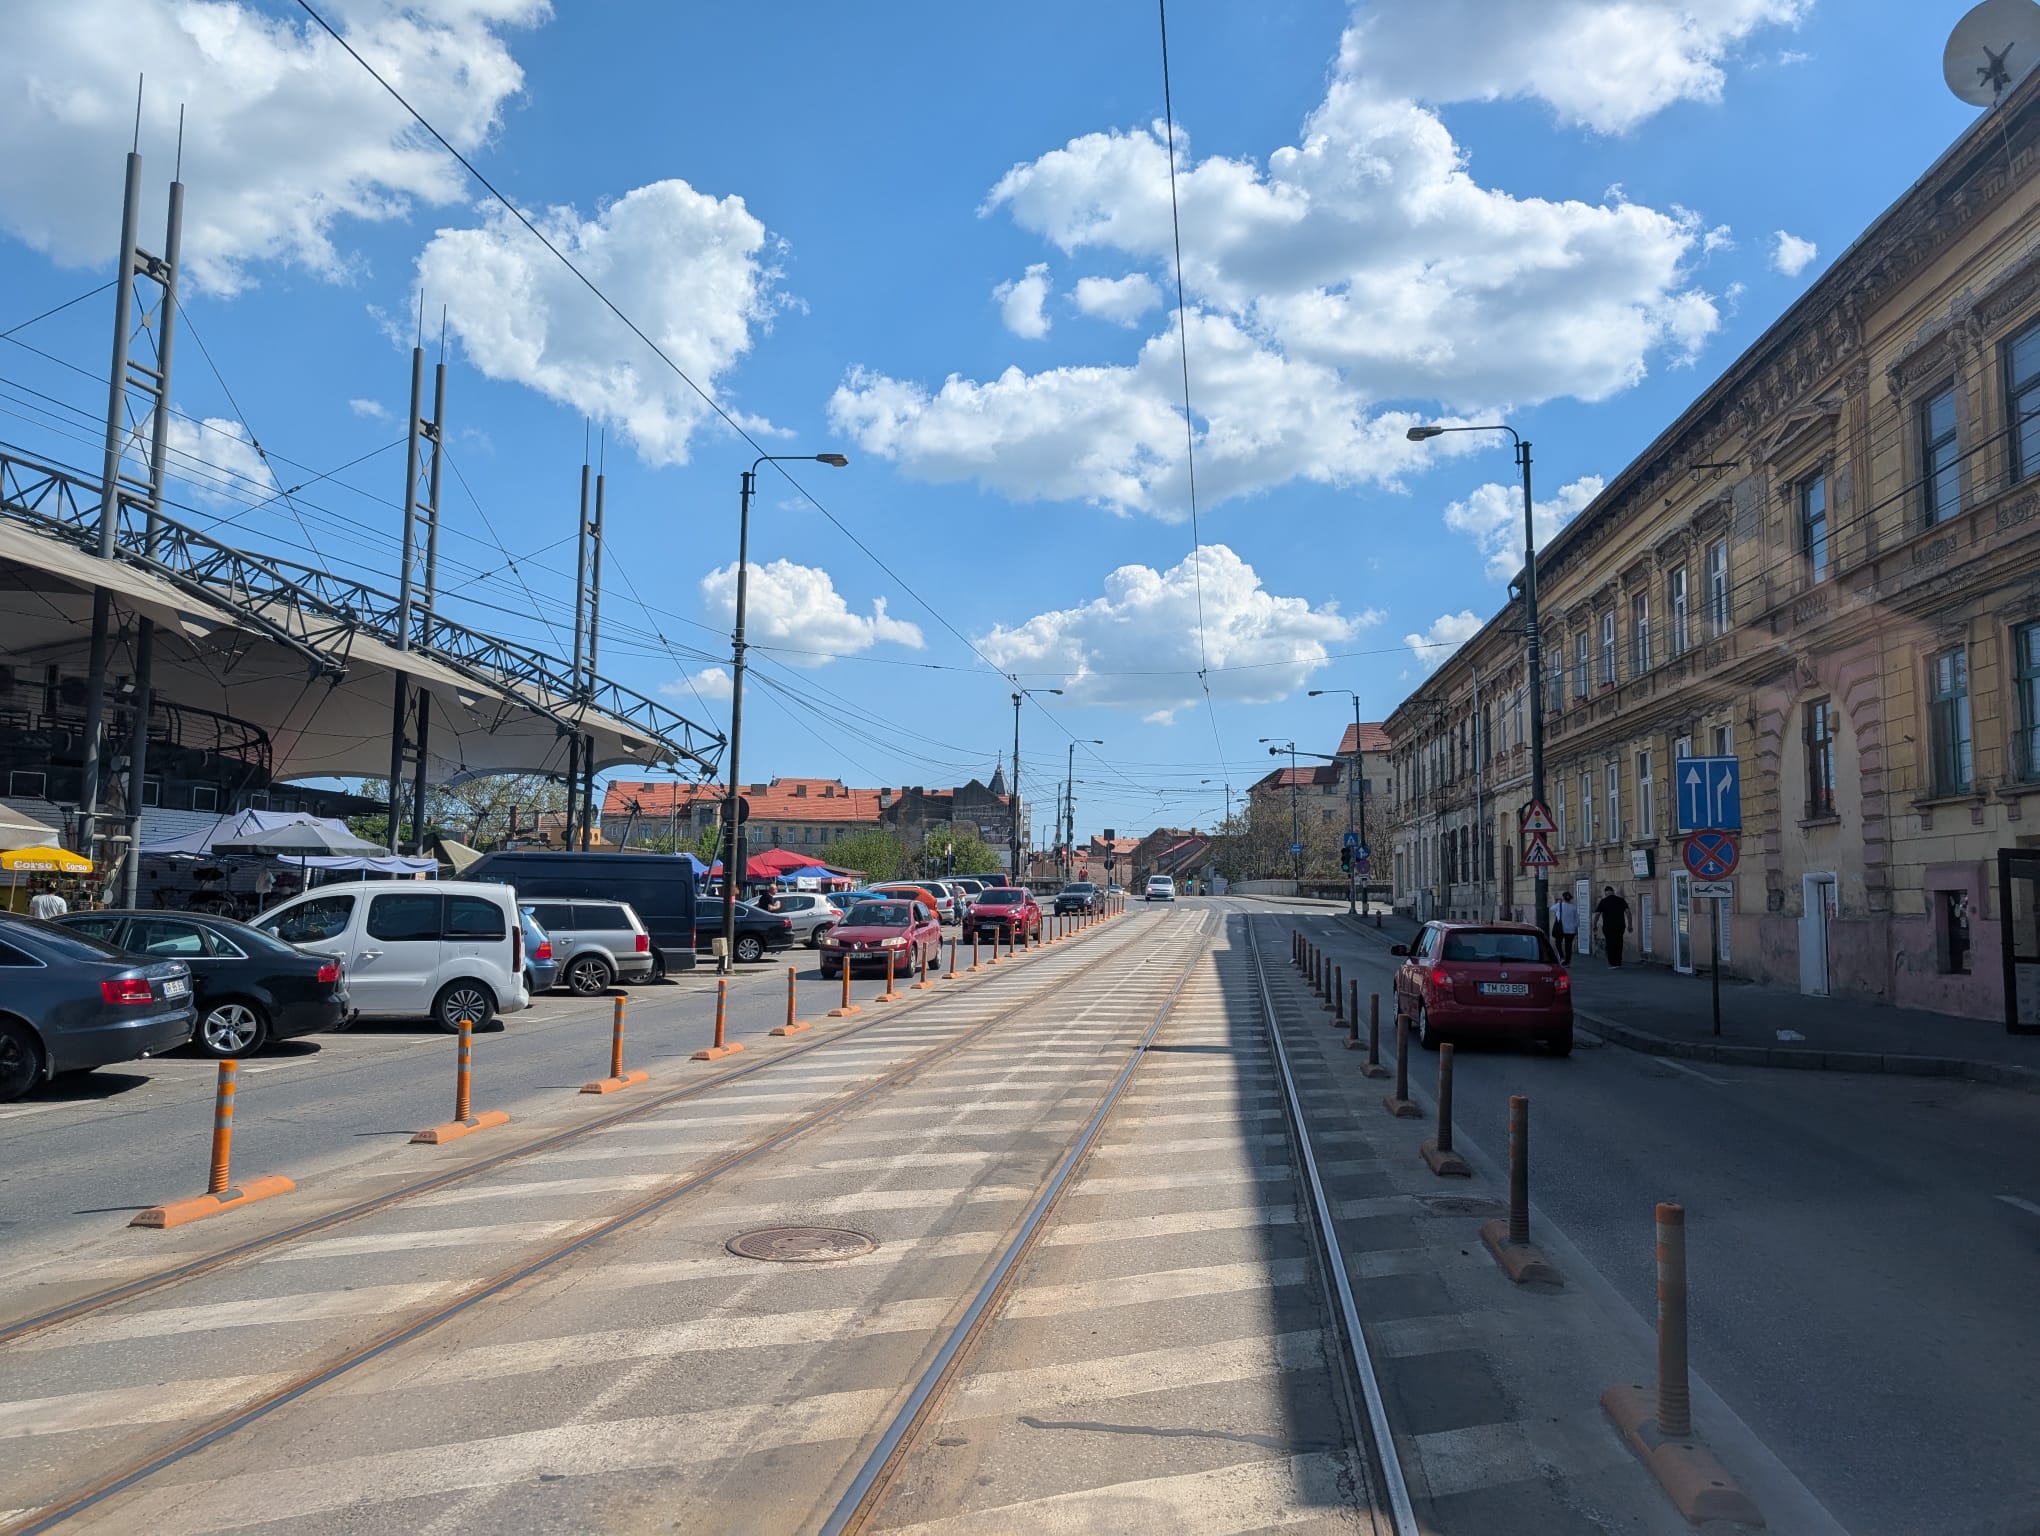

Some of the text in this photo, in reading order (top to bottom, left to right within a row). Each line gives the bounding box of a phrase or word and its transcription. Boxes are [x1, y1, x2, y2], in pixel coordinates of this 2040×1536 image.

[13, 860, 53, 869] Corso
[66, 862, 88, 871] Corso
[1486, 983, 1498, 993] TM
